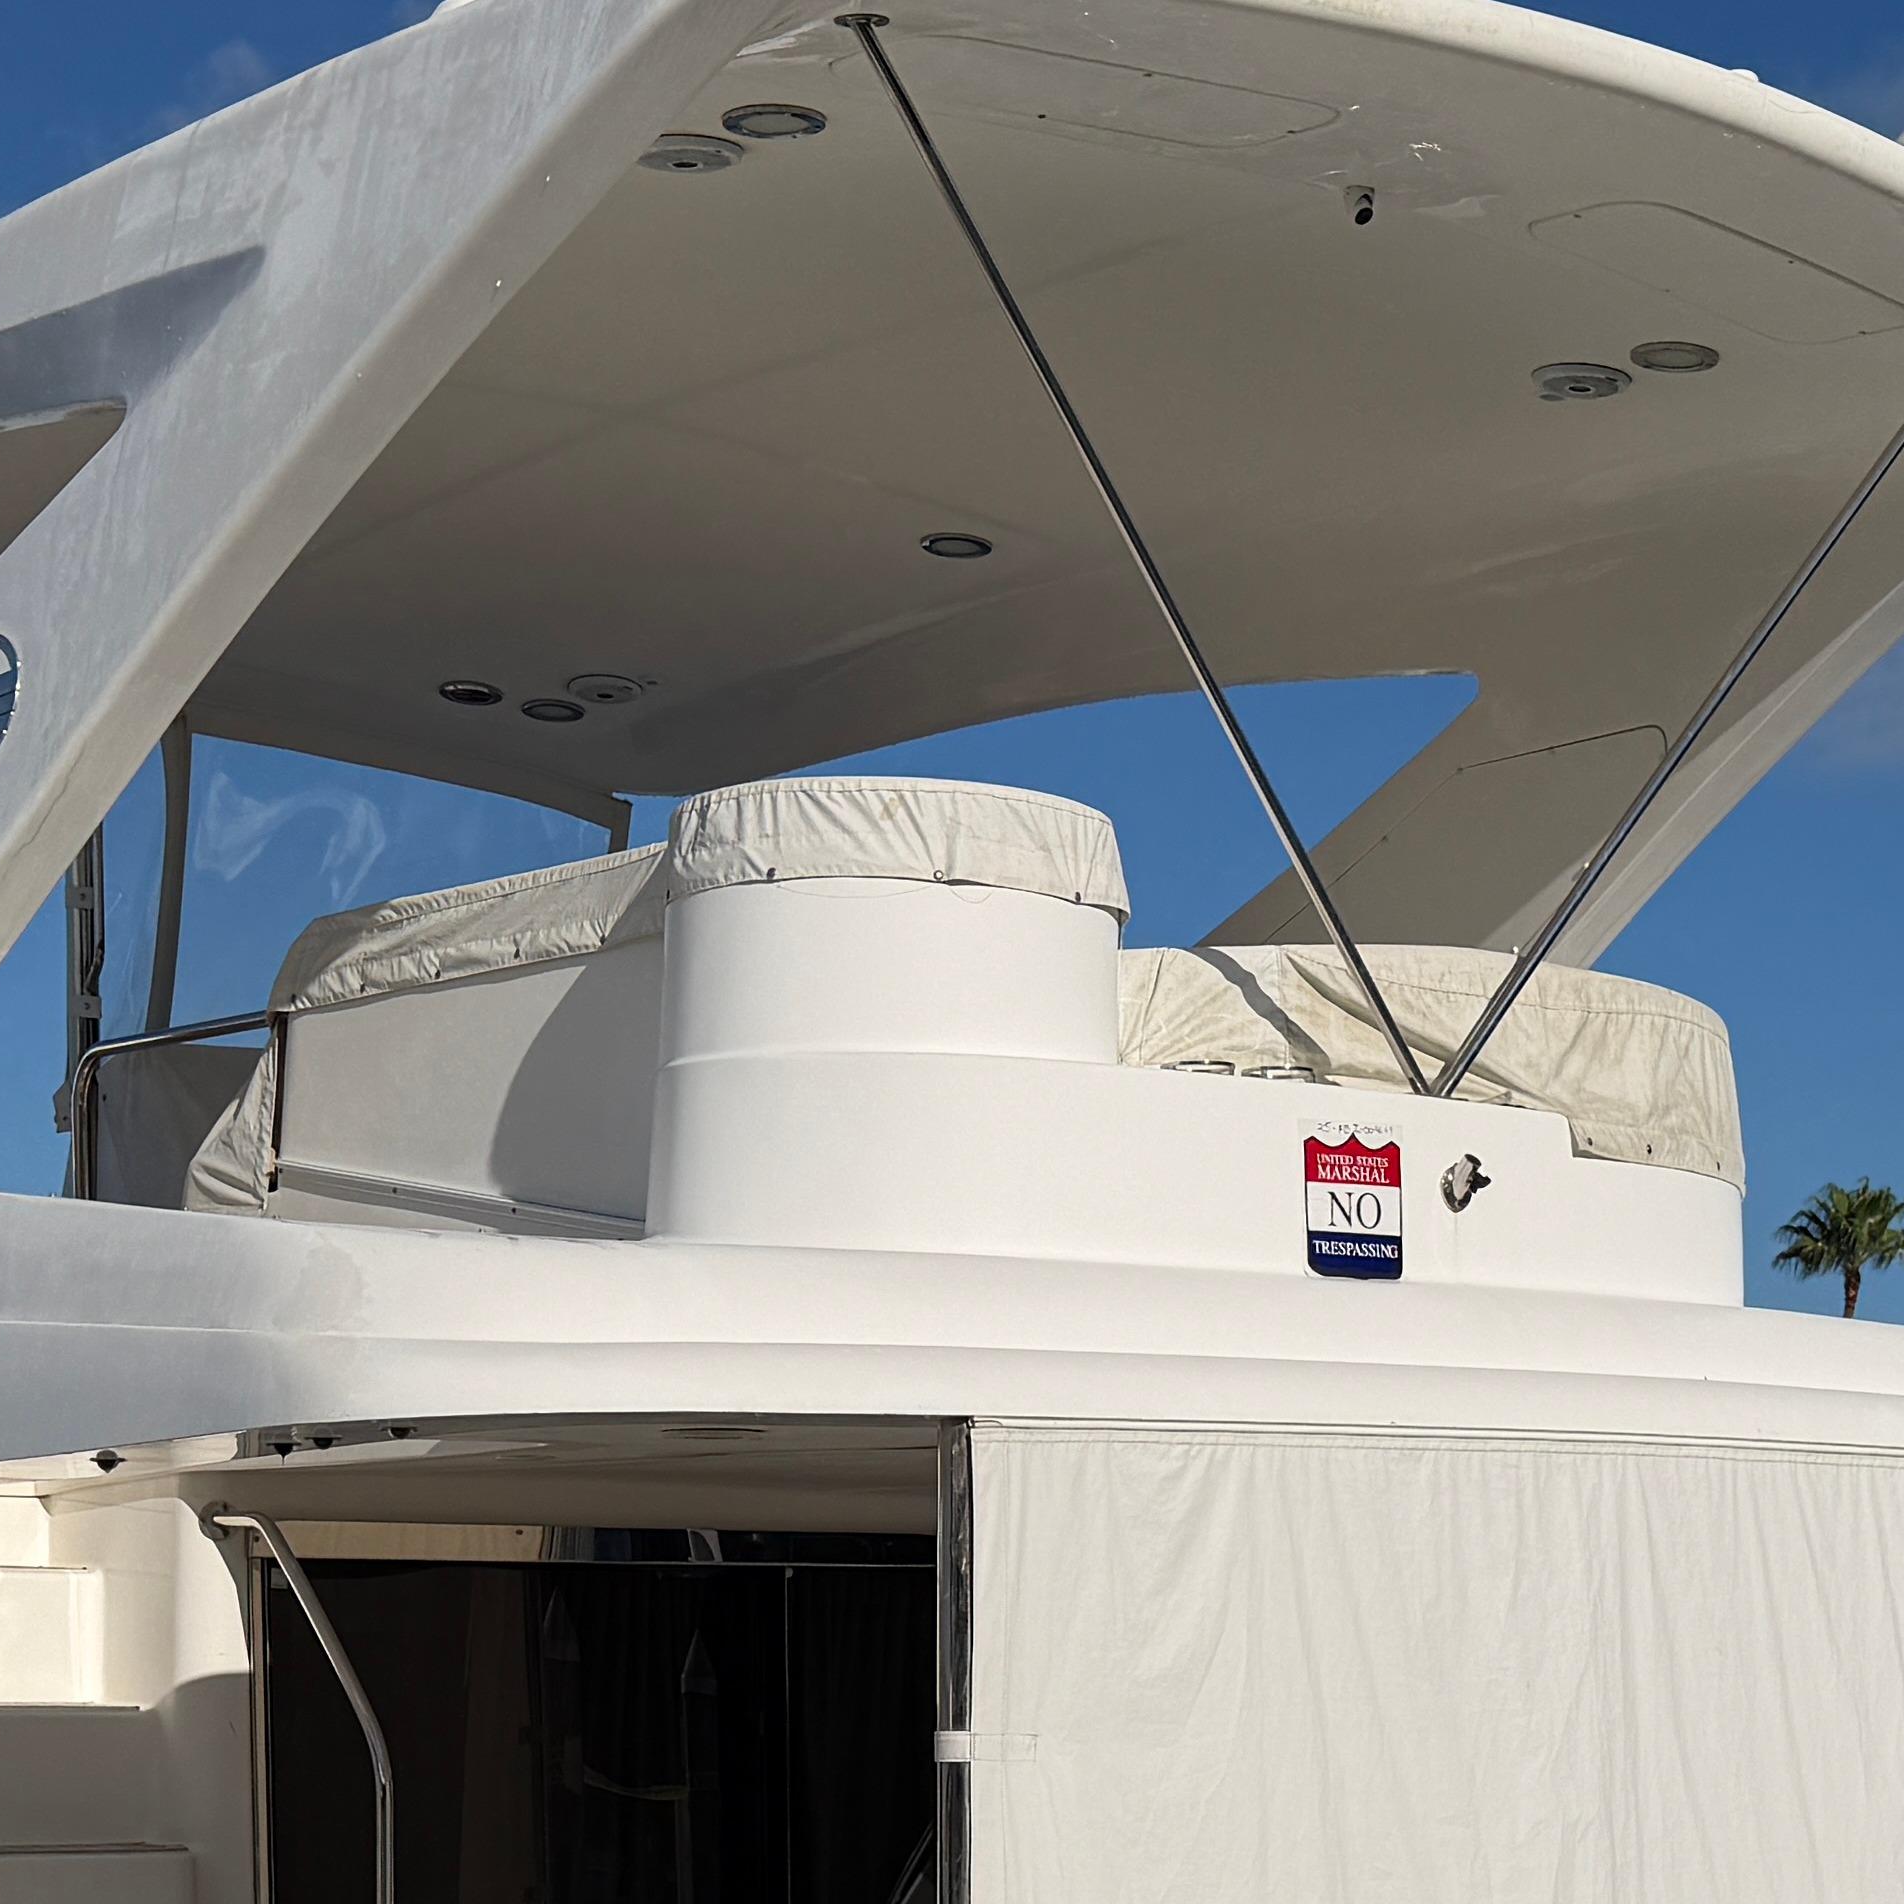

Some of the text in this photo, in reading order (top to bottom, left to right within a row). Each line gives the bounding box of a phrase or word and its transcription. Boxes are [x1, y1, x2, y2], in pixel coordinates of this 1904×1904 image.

[1316, 1153, 1389, 1168] UNITED STATES
[1317, 1164, 1390, 1184] MARSHAL
[1327, 1190, 1382, 1230] NO
[1312, 1239, 1399, 1260] TRESPASSING
